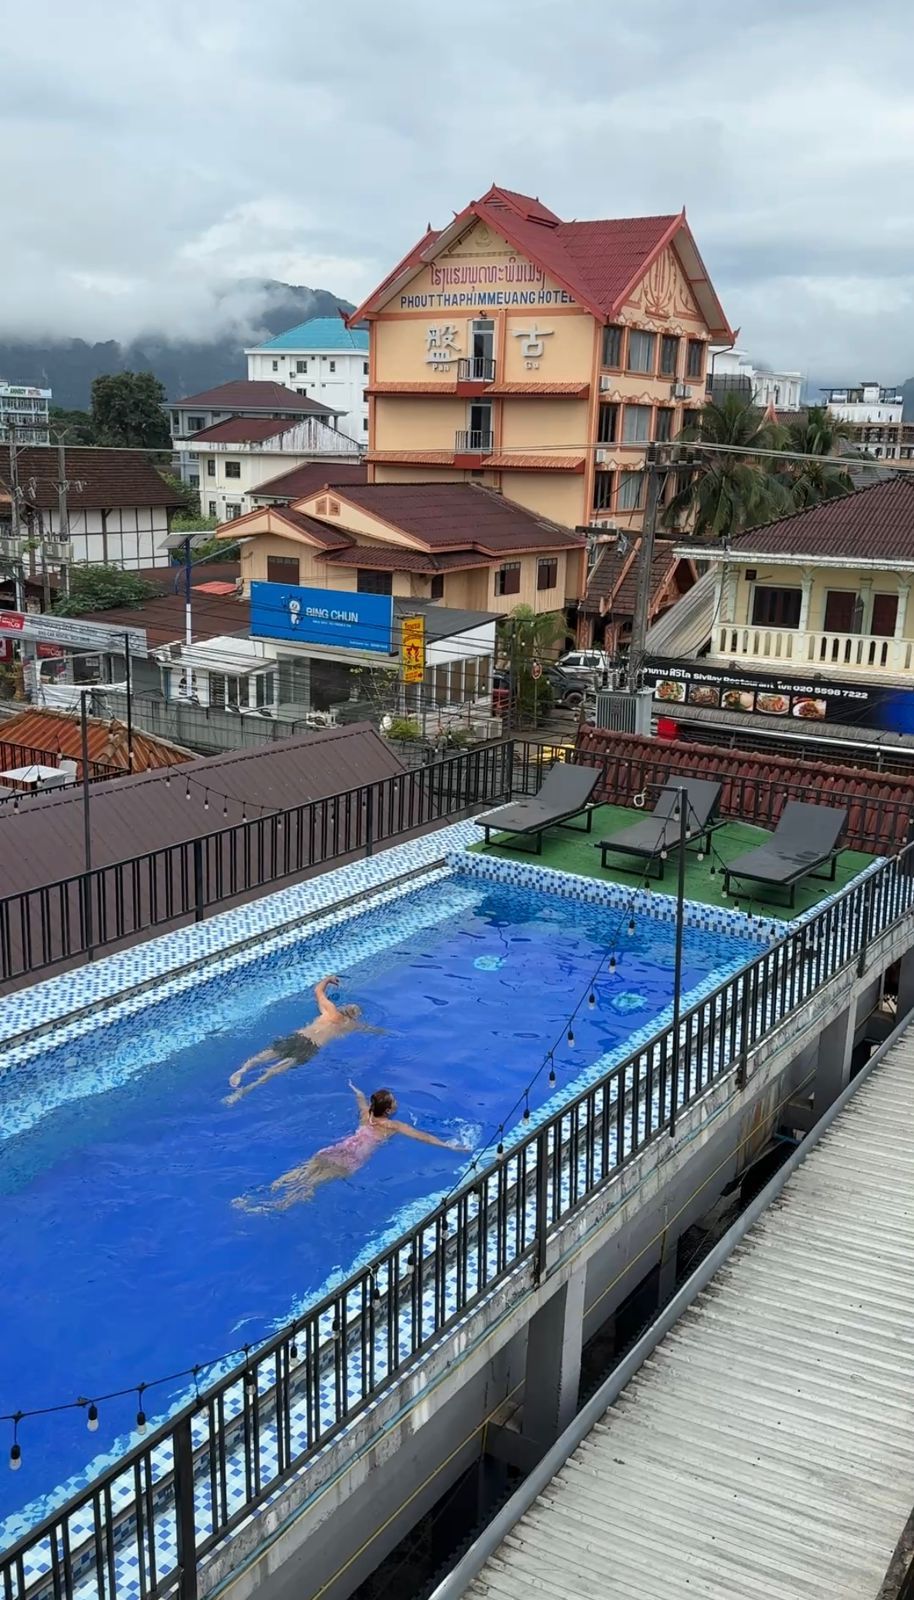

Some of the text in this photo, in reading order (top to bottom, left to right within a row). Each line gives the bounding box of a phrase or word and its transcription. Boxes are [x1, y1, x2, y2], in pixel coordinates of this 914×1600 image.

[400, 290, 576, 309] PHOUTTHAPHIMMEUANG HOTEL
[512, 323, 555, 358] 古
[305, 607, 359, 623] BING CHUN
[793, 685, 813, 693] 020
[841, 690, 869, 699] 7222
